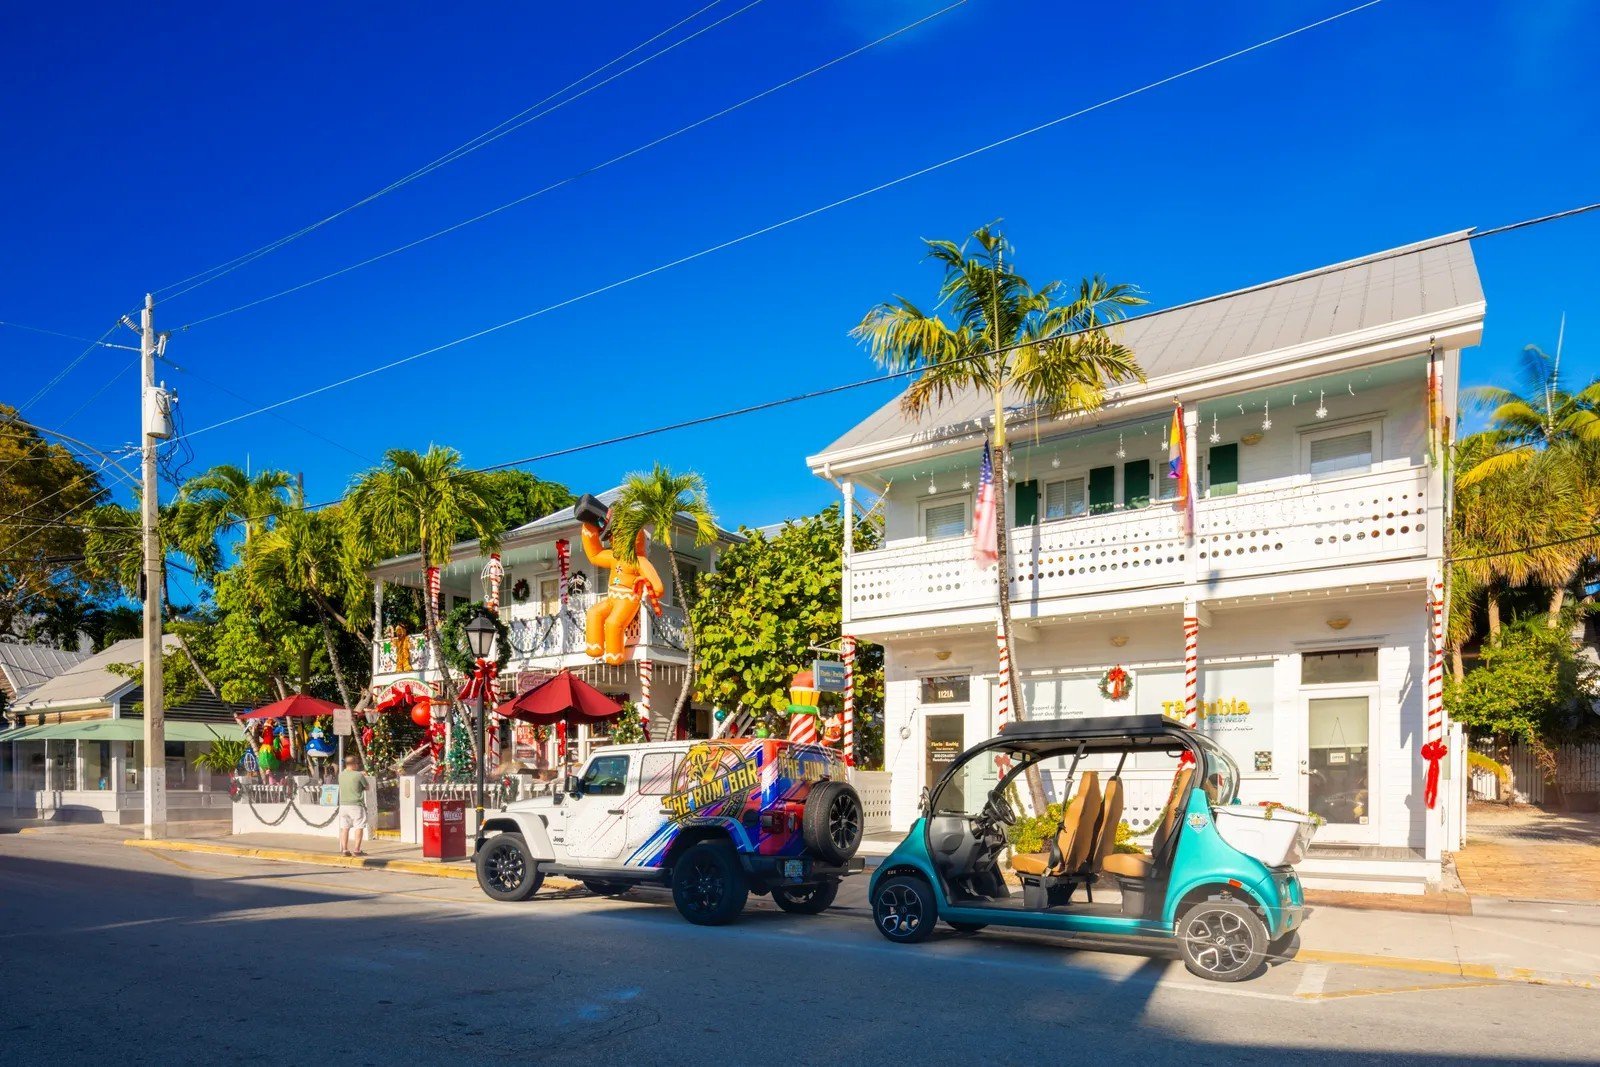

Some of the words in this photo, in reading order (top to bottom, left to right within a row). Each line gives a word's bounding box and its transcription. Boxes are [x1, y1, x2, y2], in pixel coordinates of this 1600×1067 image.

[661, 793, 691, 819] THE
[692, 778, 725, 808] RUM
[727, 758, 758, 793] BAR
